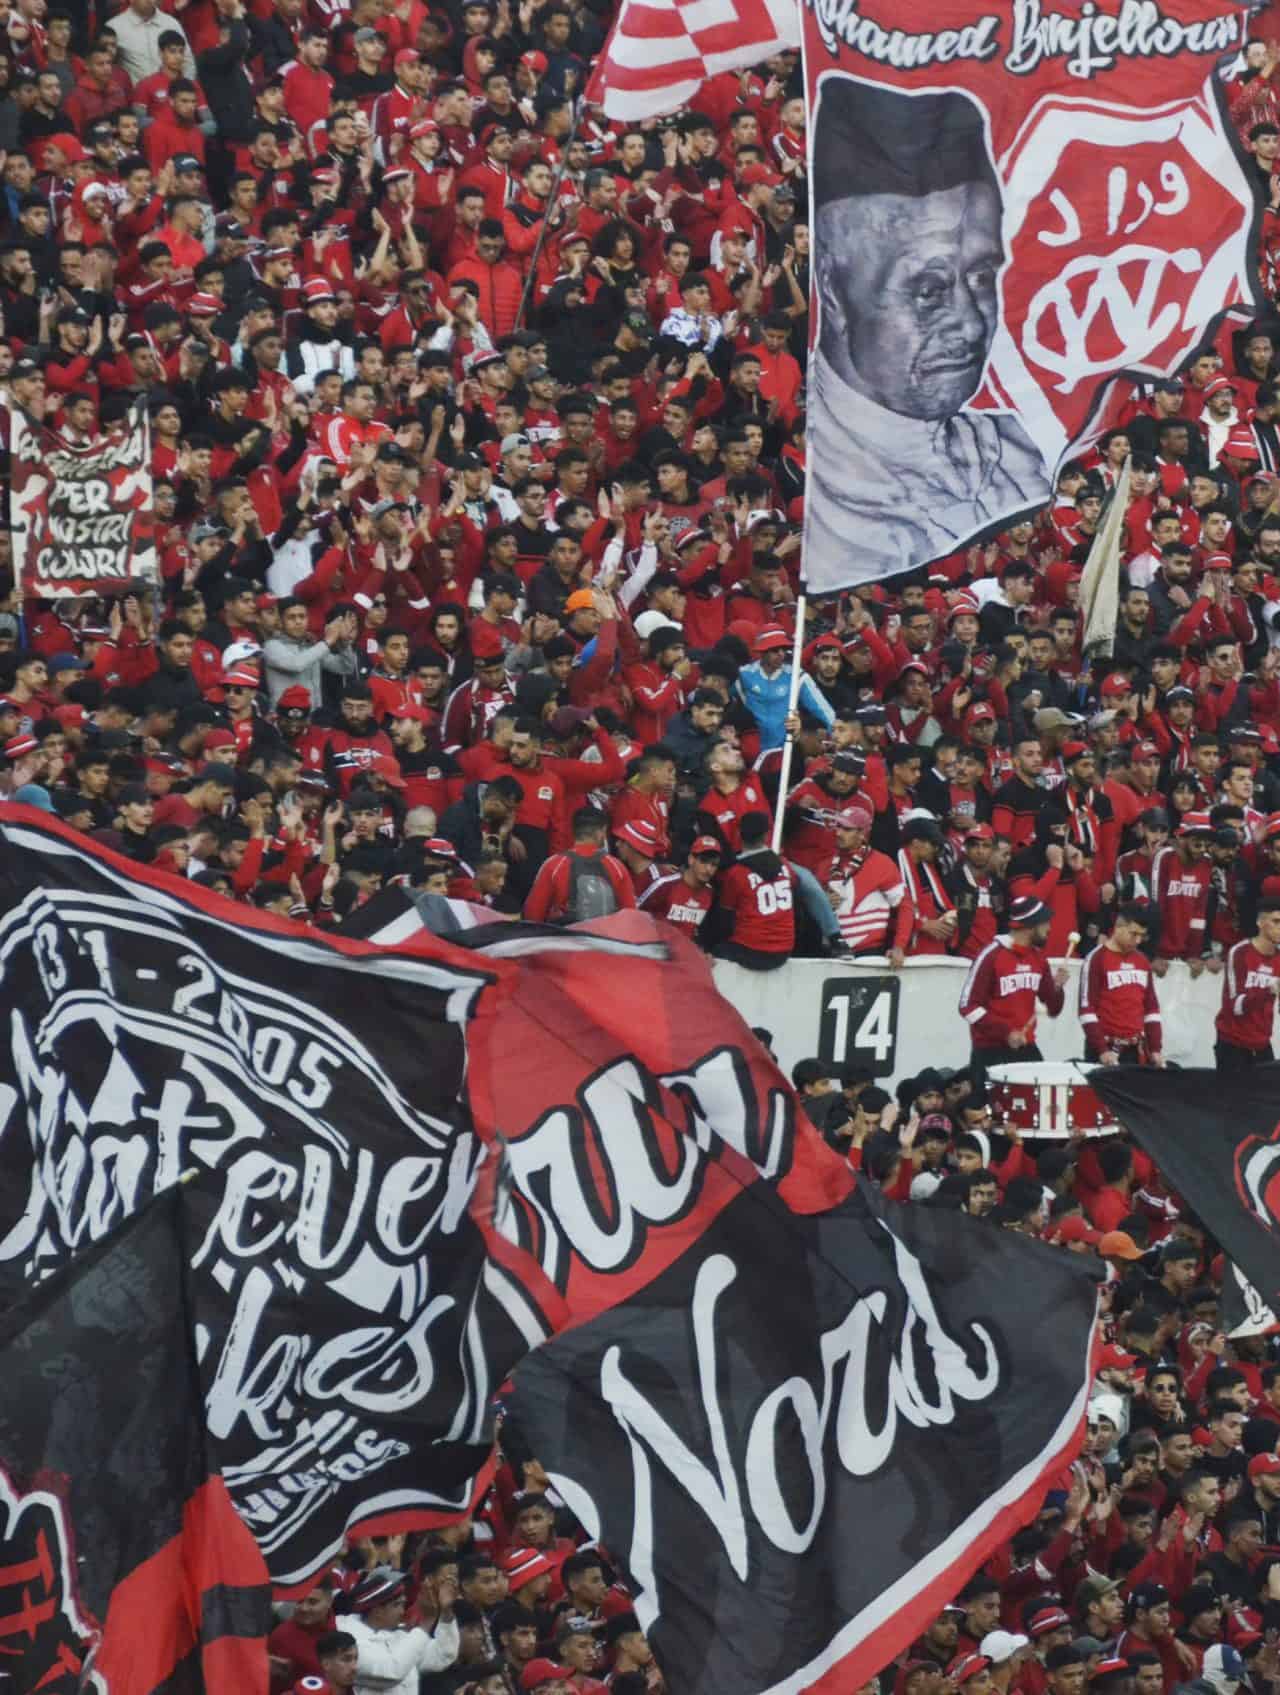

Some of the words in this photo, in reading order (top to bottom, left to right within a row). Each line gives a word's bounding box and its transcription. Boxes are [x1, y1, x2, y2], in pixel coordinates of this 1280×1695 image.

[756, 878, 793, 916] 05
[826, 991, 894, 1064] 14
[600, 1215, 1000, 1634] Nord
